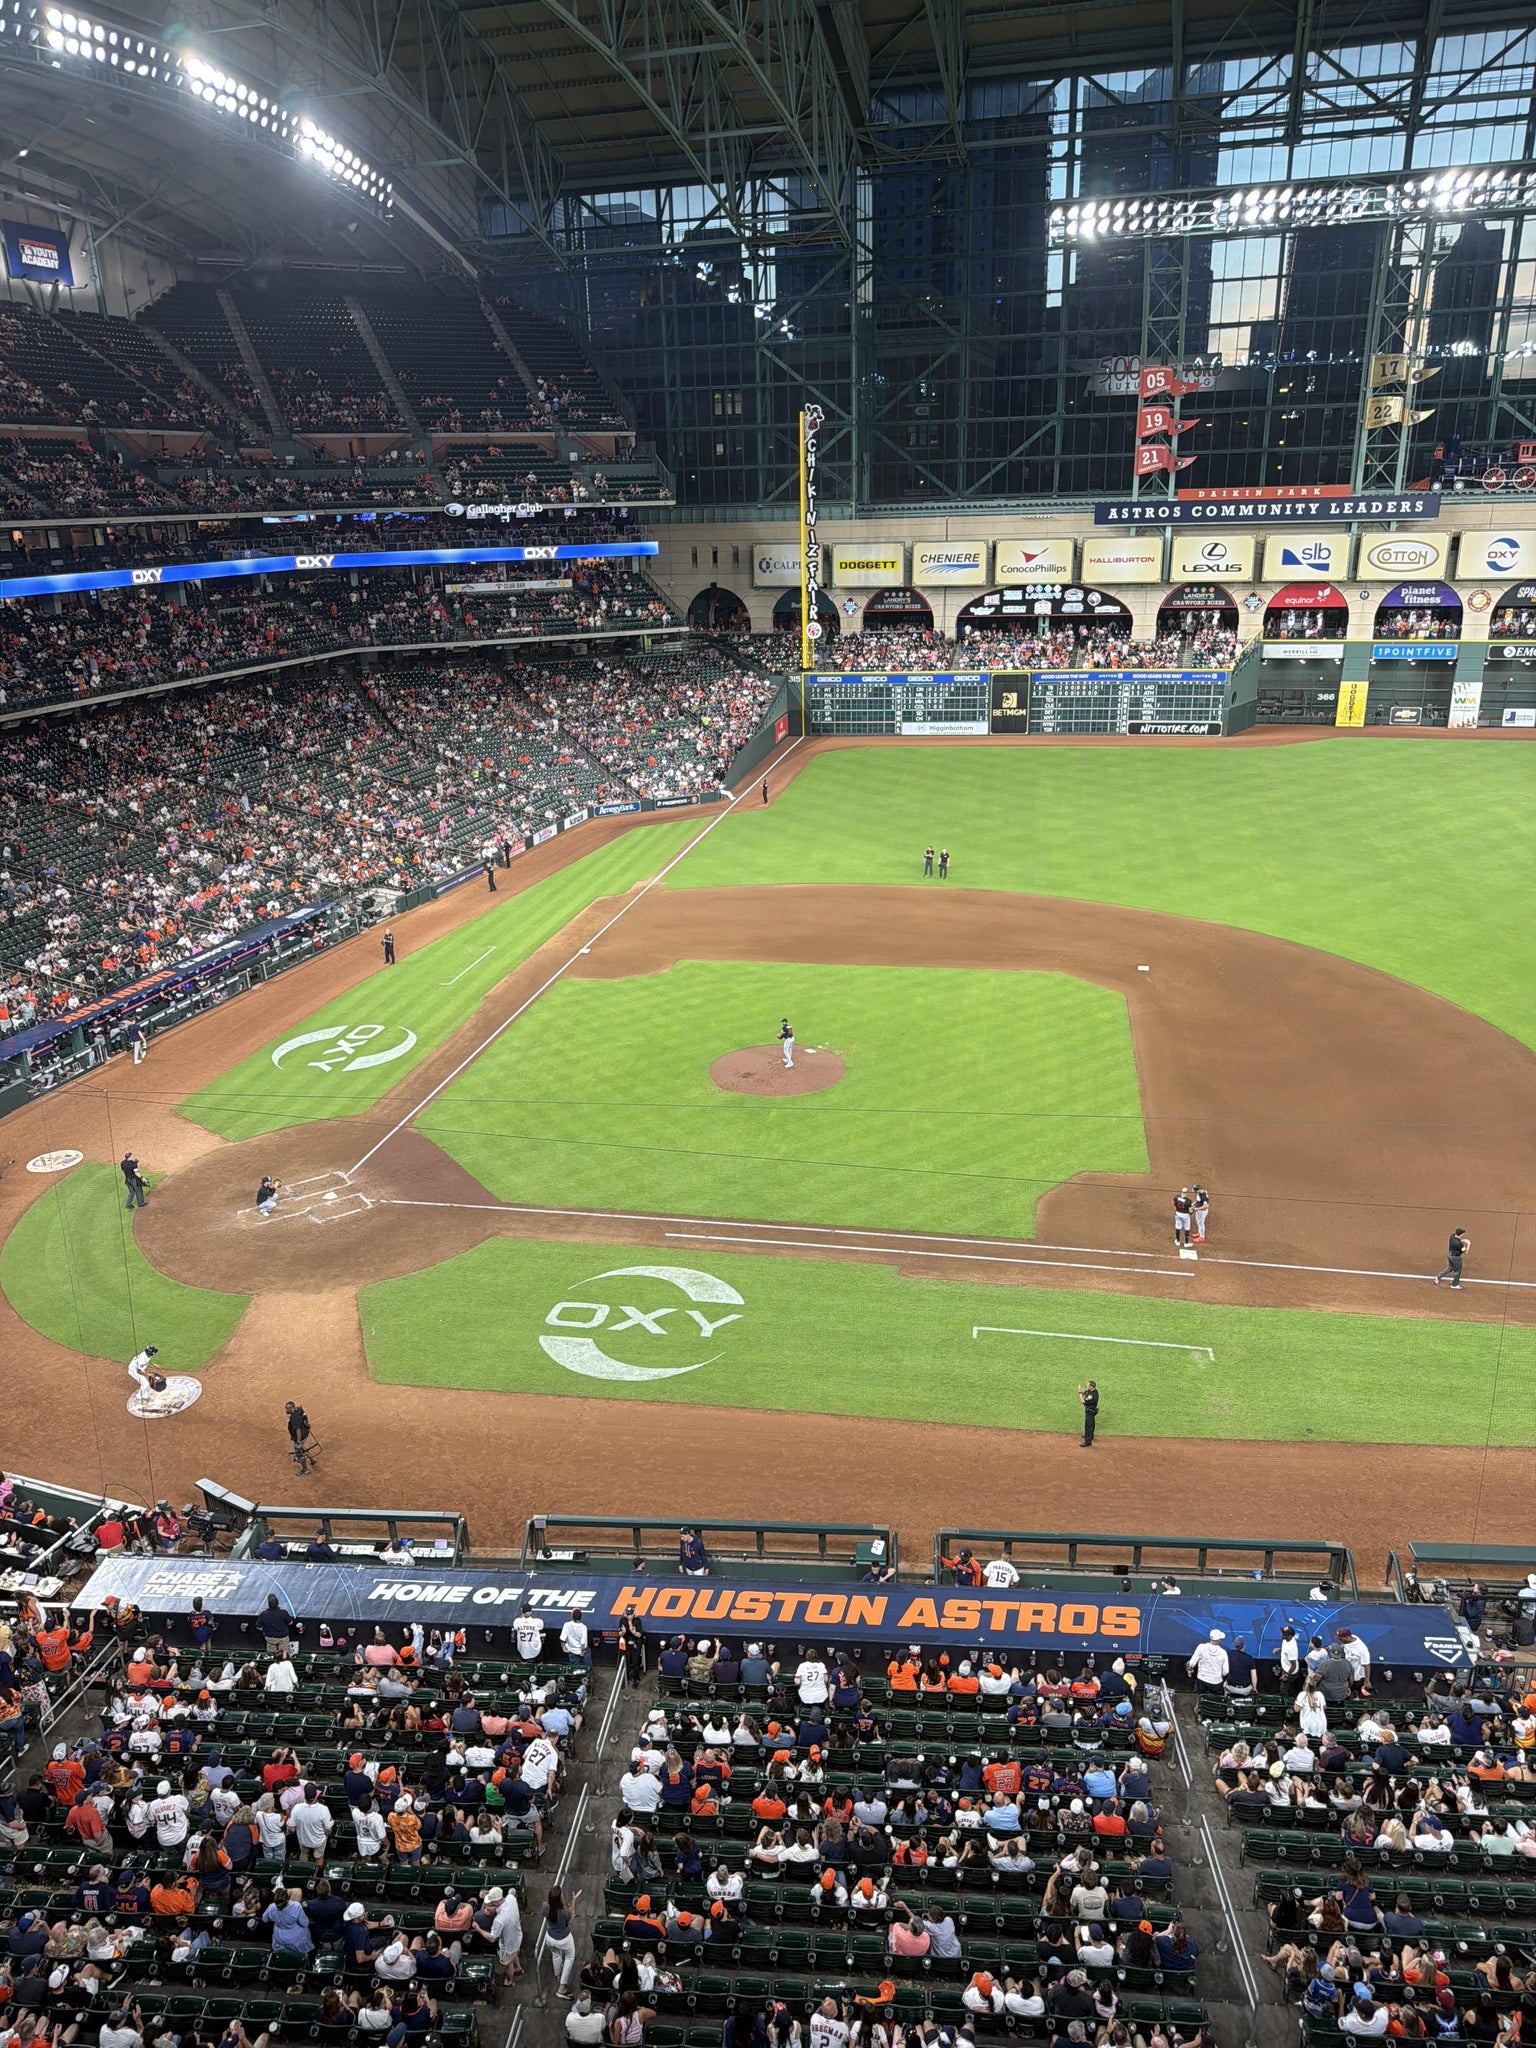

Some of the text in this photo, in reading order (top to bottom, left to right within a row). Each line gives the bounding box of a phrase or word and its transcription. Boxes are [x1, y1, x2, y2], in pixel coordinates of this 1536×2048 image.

[32, 245, 58, 260] YOUTH
[21, 254, 59, 270] ACADEMY
[1380, 360, 1400, 378] 17
[1146, 371, 1166, 389] 05
[1374, 404, 1393, 419] 22
[1145, 413, 1164, 428] 19
[1141, 450, 1160, 465] 21
[805, 438, 818, 526] CHIKIN
[1198, 487, 1322, 498] DAIKIN PARK
[467, 503, 543, 515] Gallagher Club
[1107, 500, 1425, 520] ASTROS COMMUNITY LEADERS
[806, 530, 820, 558] IZ
[523, 546, 558, 559] OXY
[1301, 542, 1332, 560] slb
[1487, 550, 1519, 558] OXY
[295, 555, 335, 569] OXY
[839, 560, 897, 570] DOGGETT
[920, 553, 981, 564] CHENIERE
[1089, 556, 1155, 564] HALLIBURTON
[1000, 563, 1068, 575] ConocoPhillips
[1182, 563, 1243, 573] LEXUS
[132, 568, 163, 584] OXY
[806, 561, 819, 620] FAIR
[1401, 586, 1436, 597] planet
[1284, 596, 1315, 605] equinor
[1404, 595, 1442, 604] fitness
[1378, 647, 1452, 656] 1POINTFIVE
[788, 675, 801, 683] 315
[1317, 693, 1335, 701] 366
[1139, 724, 1209, 734] NITTOTIRE.COM
[111, 970, 177, 999] DAIKIN
[57, 997, 118, 1024] PARK
[307, 1024, 386, 1072] OXY
[544, 1301, 744, 1338] OXY
[148, 1570, 226, 1585] CHASE
[995, 1571, 1008, 1583] 15
[141, 1583, 238, 1598] THE FIGHT
[368, 1584, 598, 1608] HOME OF THE
[609, 1586, 1142, 1637] HOUSTON ASTROS
[519, 1631, 534, 1642] 27
[806, 1671, 819, 1682] 27
[110, 1740, 122, 1750] 2
[169, 1741, 181, 1751] 3
[528, 1748, 547, 1766] 27
[997, 1777, 1014, 1789] 27
[1028, 1775, 1050, 1789] 27
[216, 1804, 228, 1812] 27
[156, 1812, 178, 1825] 44
[820, 2035, 830, 2048] 2
